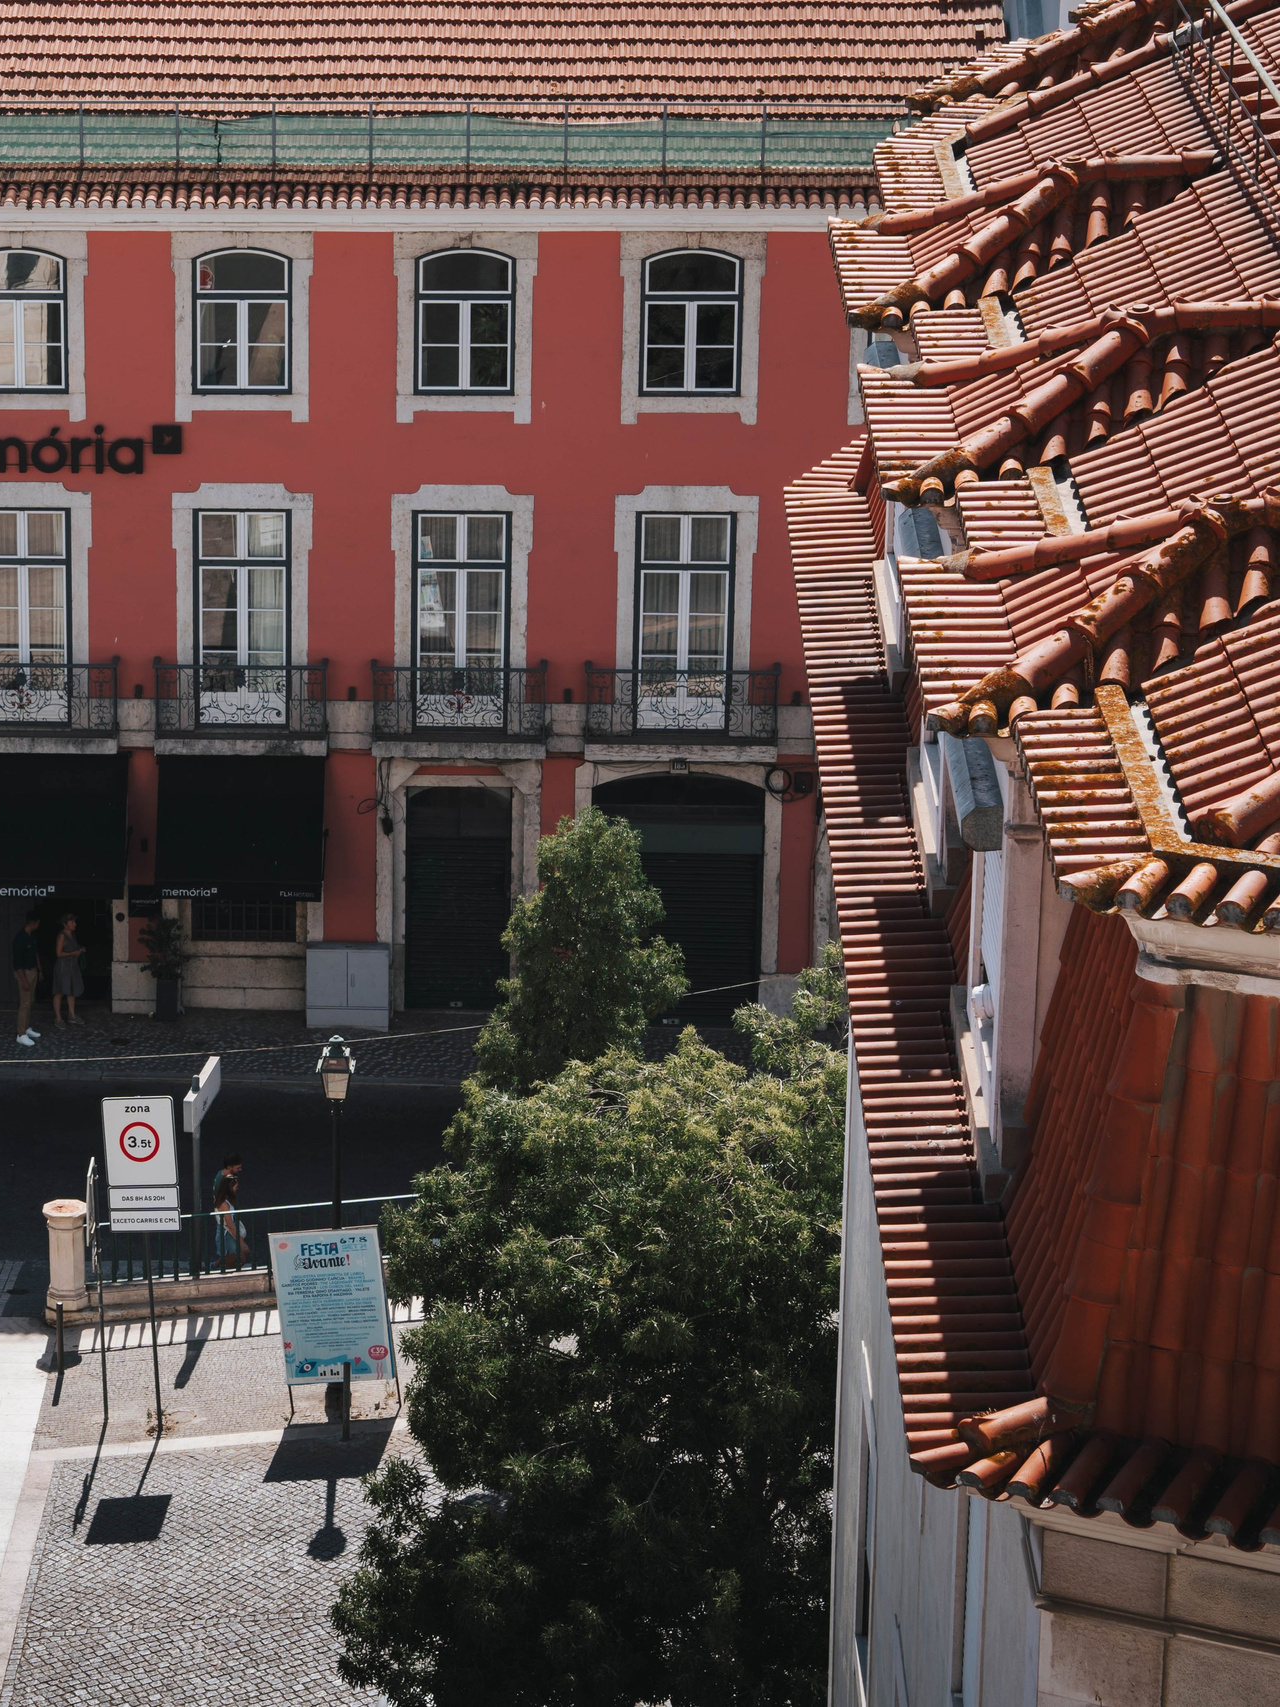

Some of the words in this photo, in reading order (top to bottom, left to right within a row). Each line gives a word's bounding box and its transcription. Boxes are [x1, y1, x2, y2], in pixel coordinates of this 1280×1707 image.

[162, 888, 211, 897] memória
[124, 1105, 150, 1113] zona
[128, 1136, 152, 1148] 3.5t
[300, 1242, 339, 1256] FESTA
